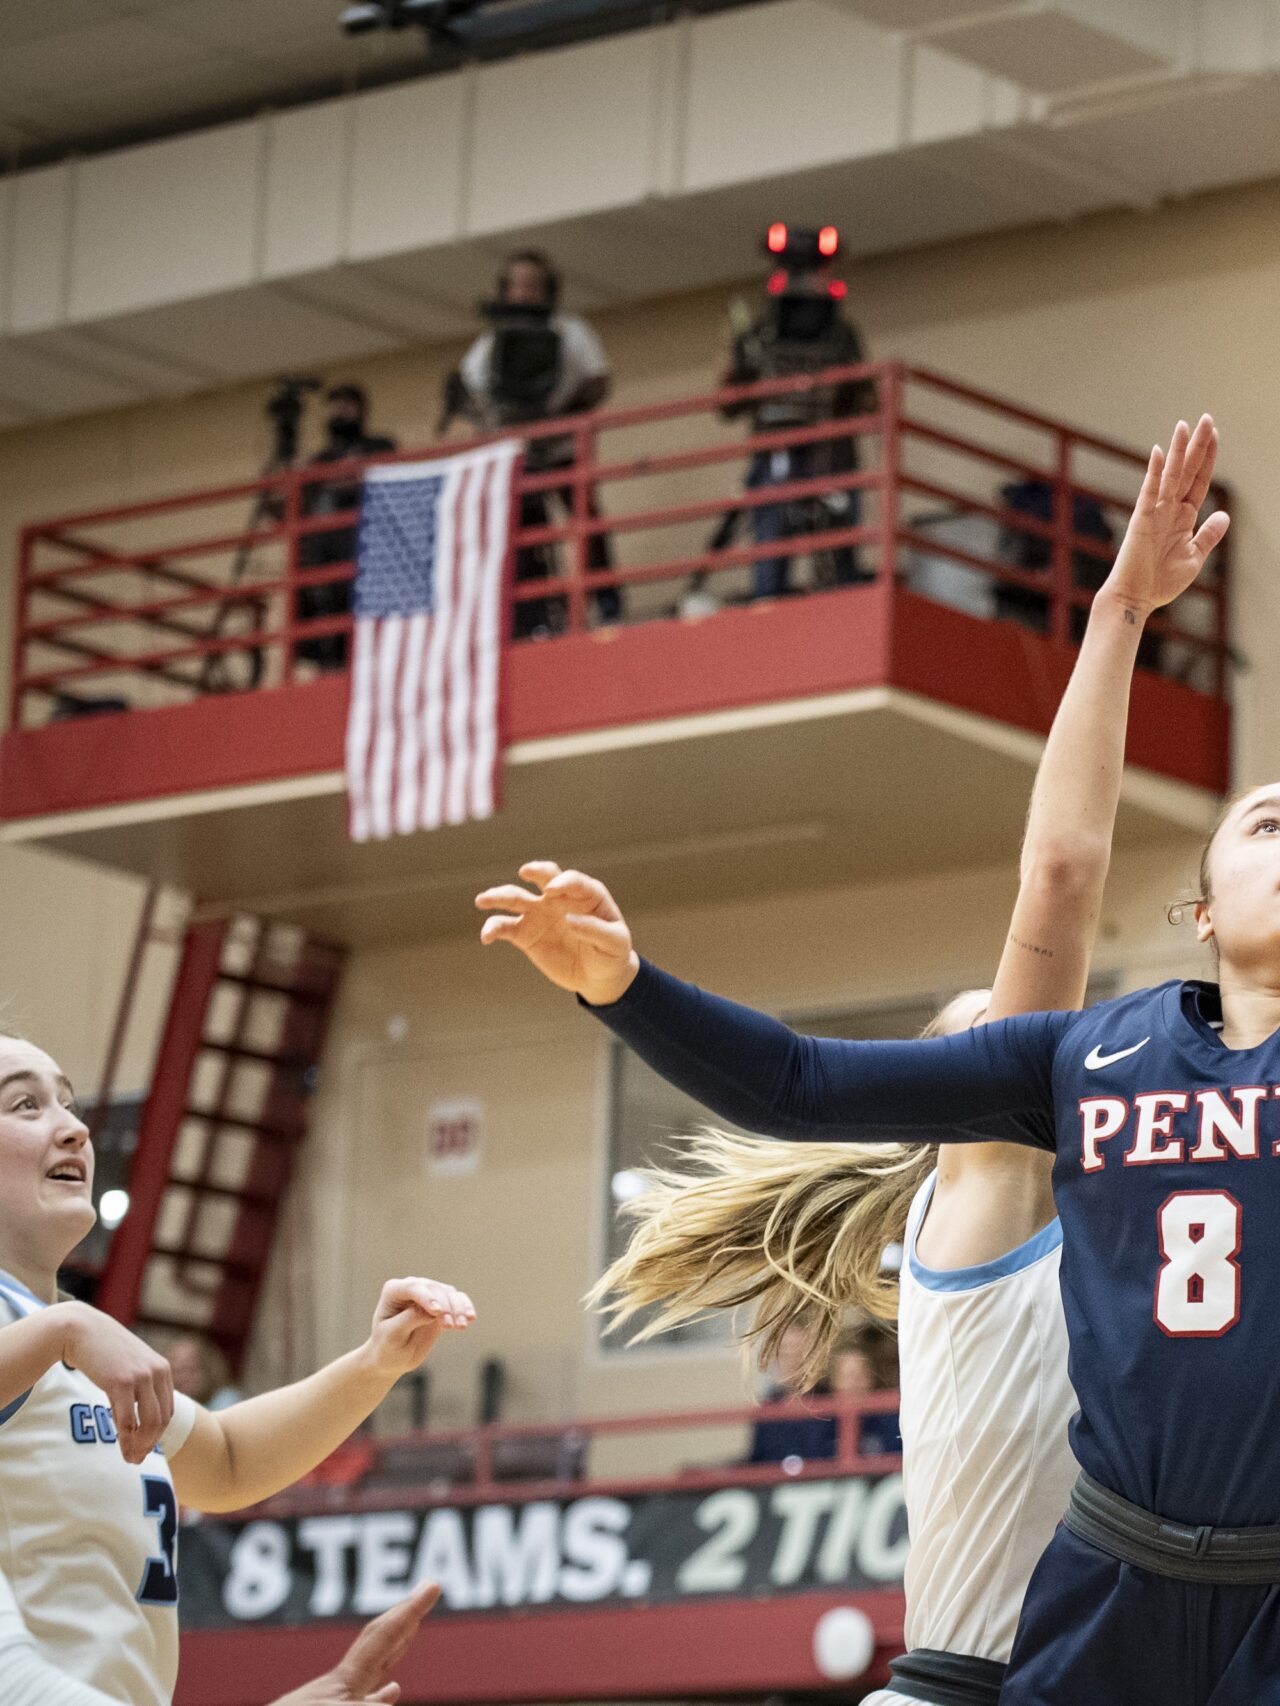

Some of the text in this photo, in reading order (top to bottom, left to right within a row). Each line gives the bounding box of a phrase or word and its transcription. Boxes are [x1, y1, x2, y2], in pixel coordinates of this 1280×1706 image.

[1153, 1188, 1243, 1338] 8
[223, 1520, 293, 1620] 8
[298, 1496, 652, 1618] TEAMS.
[675, 1487, 760, 1593] 2
